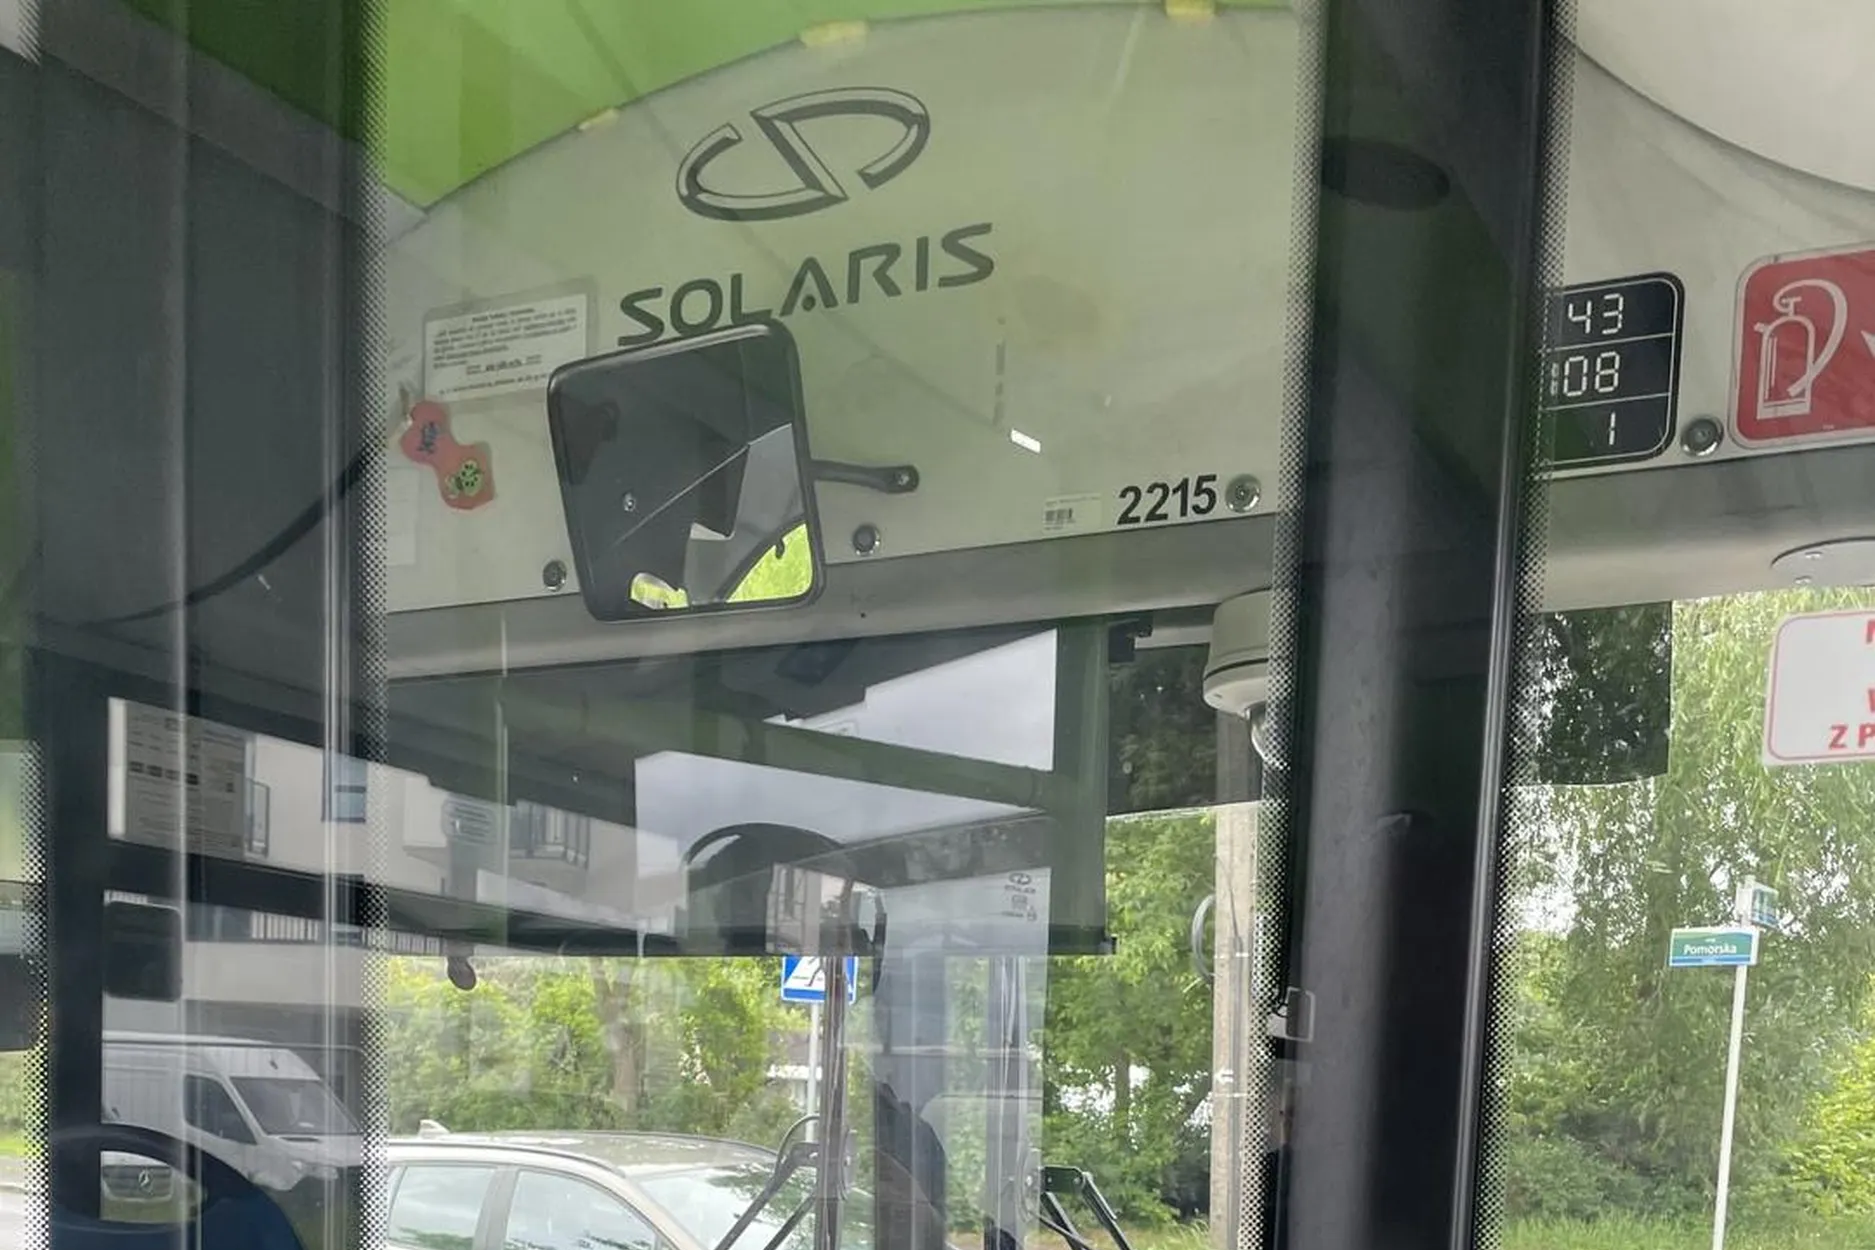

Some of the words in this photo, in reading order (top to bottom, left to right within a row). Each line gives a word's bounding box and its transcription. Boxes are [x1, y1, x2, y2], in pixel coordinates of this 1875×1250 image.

[618, 222, 995, 346] SOLARIS
[1568, 293, 1624, 334] 43
[1608, 412, 1616, 446] 1
[1117, 474, 1217, 526] 2215
[1829, 724, 1848, 749] Z
[1684, 943, 1737, 955] Pomorska
